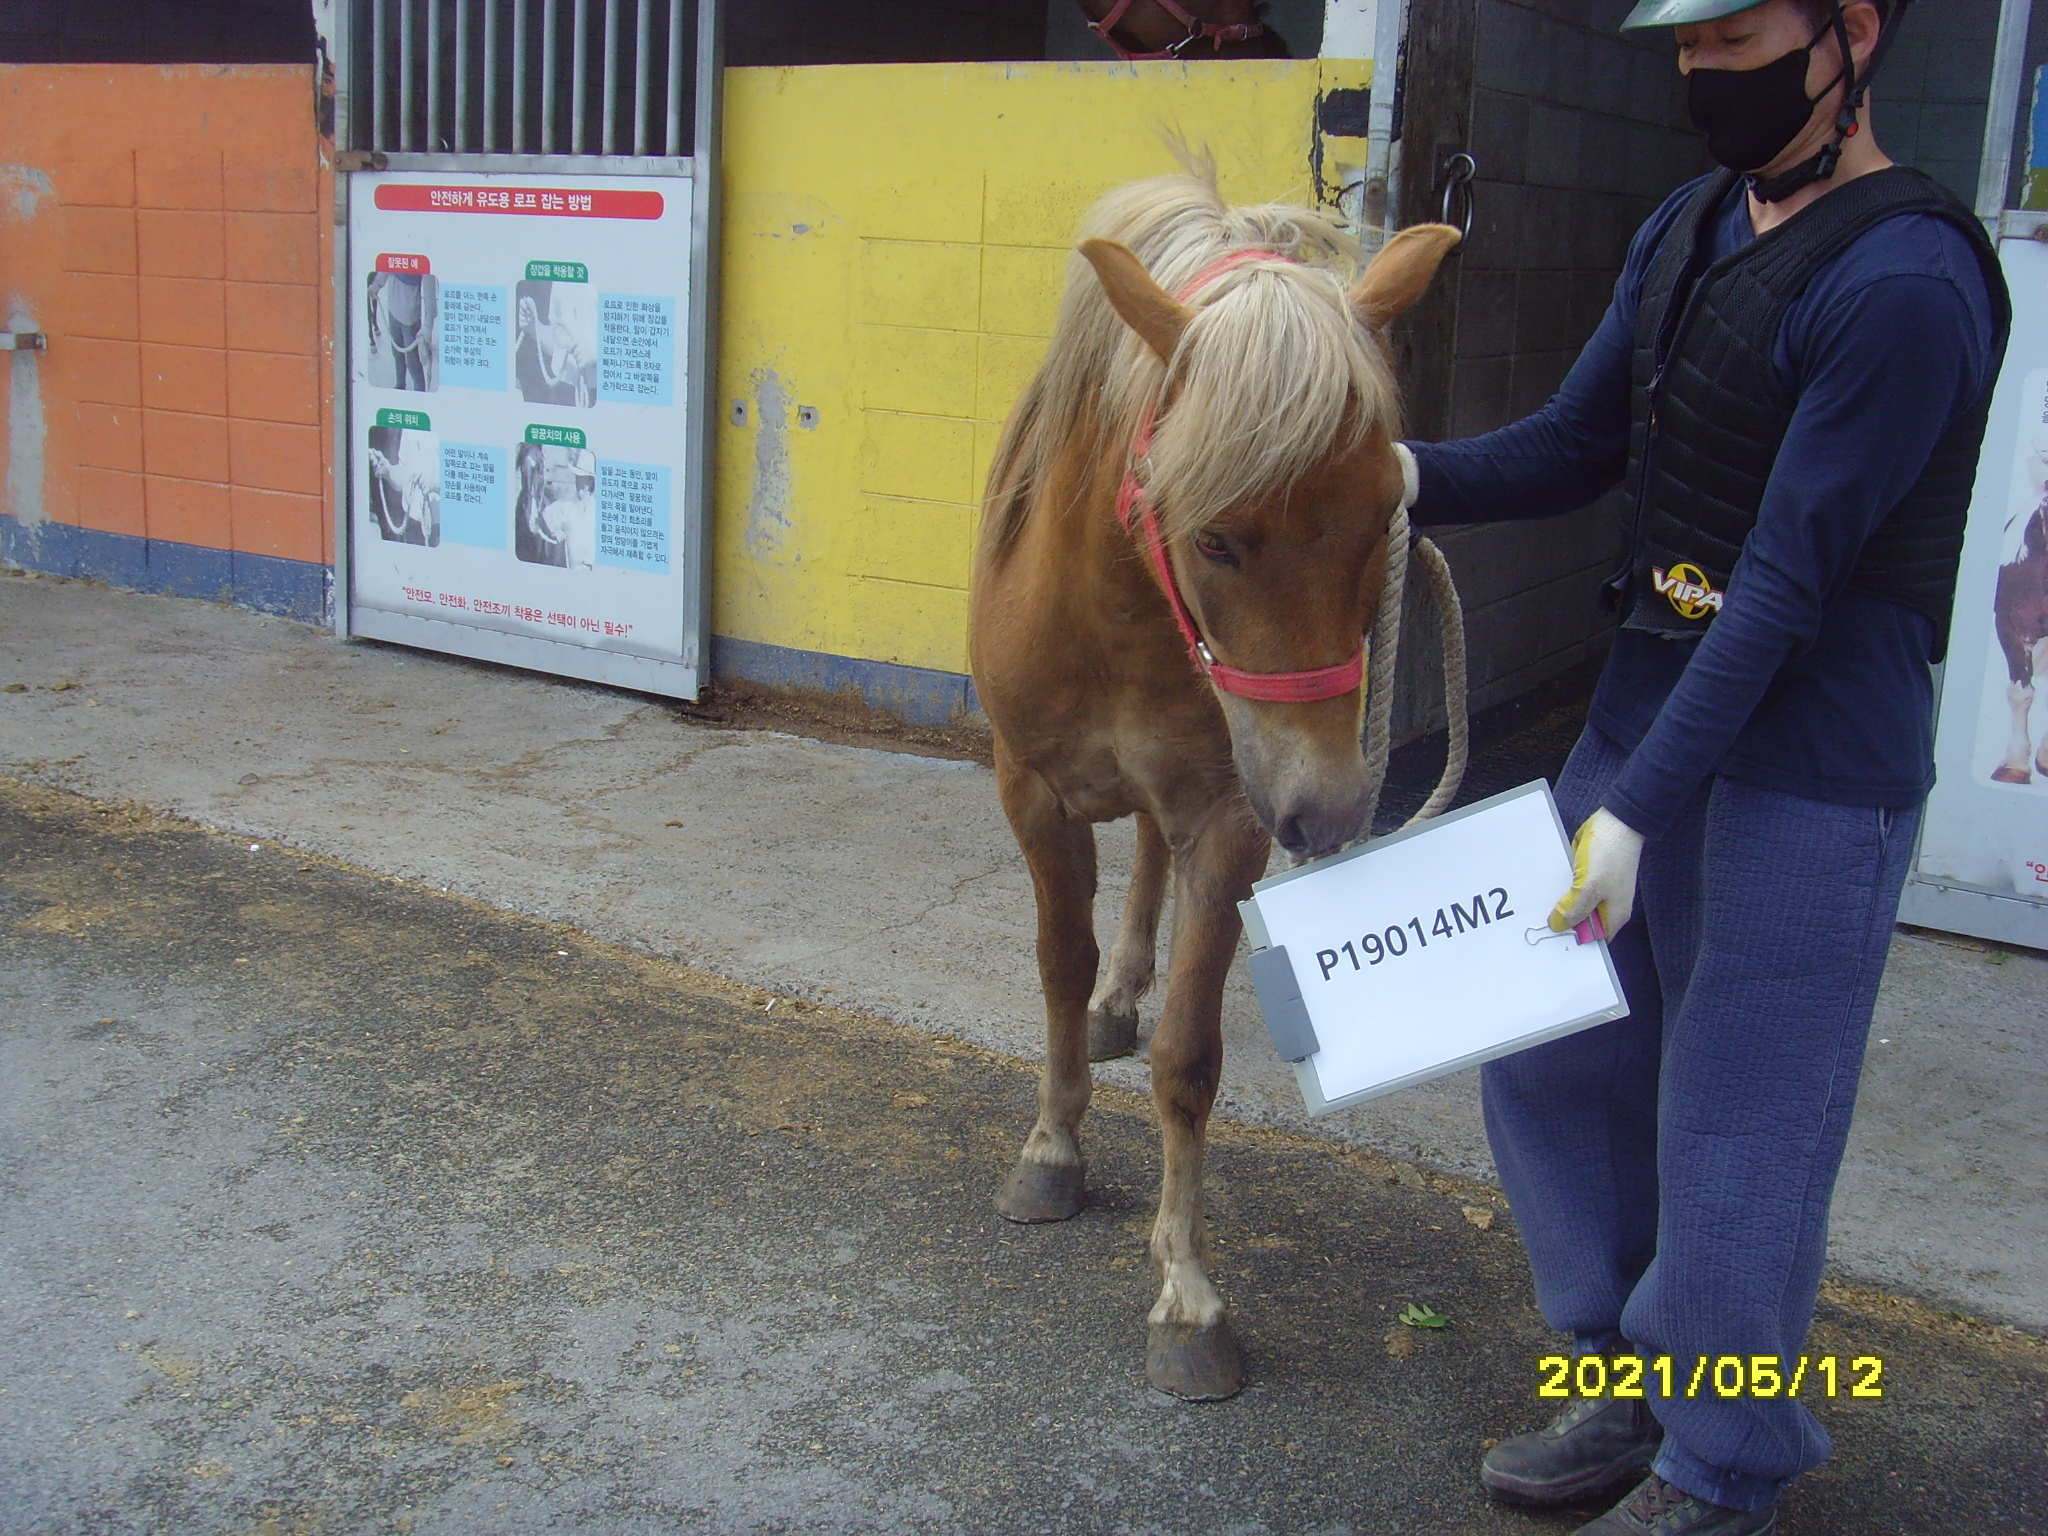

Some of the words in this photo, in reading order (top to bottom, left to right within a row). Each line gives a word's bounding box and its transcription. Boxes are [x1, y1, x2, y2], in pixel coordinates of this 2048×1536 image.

[430, 190, 473, 207] 안전하게
[476, 191, 510, 209] 유도용
[513, 192, 537, 208] 로프
[540, 193, 565, 210] 잡는
[568, 194, 592, 211] 방법
[387, 256, 409, 269] 잘못된
[530, 264, 551, 277] 장갑을
[553, 264, 575, 278] 착용할
[577, 266, 584, 279] 것
[444, 290, 461, 300] 로프를
[463, 291, 475, 300] 어느
[603, 299, 623, 310] 로프로
[625, 301, 639, 311] 인한
[641, 302, 661, 313] 화상을
[444, 312, 456, 321] 말이
[458, 312, 475, 322] 갑자기
[603, 311, 630, 323] 방지하기
[632, 313, 646, 324] 위해
[648, 314, 668, 325] 장갑을
[444, 323, 461, 332] 로프가
[603, 322, 631, 334] 착용한다.
[633, 325, 647, 336] 말이
[649, 326, 670, 337] 갑자기
[444, 334, 461, 343] 로프가
[477, 336, 483, 346] 손
[485, 337, 497, 347] 또는
[603, 335, 630, 346] 내달으면
[631, 336, 658, 348] 손안에서
[444, 345, 461, 354] 손가락
[602, 346, 623, 357] 로프가
[643, 361, 662, 371] 8자로
[624, 371, 631, 380] 그
[602, 380, 635, 392] 손가락으로
[637, 383, 659, 395] 잡는다.
[388, 411, 403, 424] 손의
[404, 413, 419, 426] 위치
[531, 427, 562, 442] 팔꿈치의
[564, 431, 581, 444] 사용
[444, 448, 456, 458] 어린
[645, 471, 658, 481] 말이
[621, 480, 639, 490] 쪽으로
[444, 491, 461, 501] 로프를
[629, 492, 653, 503] 팔꿈치로
[646, 552, 653, 561] 수
[438, 592, 469, 611] 안전화,
[473, 598, 511, 618] 안전조끼
[514, 605, 543, 623] 착용은
[547, 611, 576, 629] 선택이
[580, 617, 600, 633] 아닌
[604, 621, 633, 638] 필수!”
[1315, 886, 1515, 982] P19014M2
